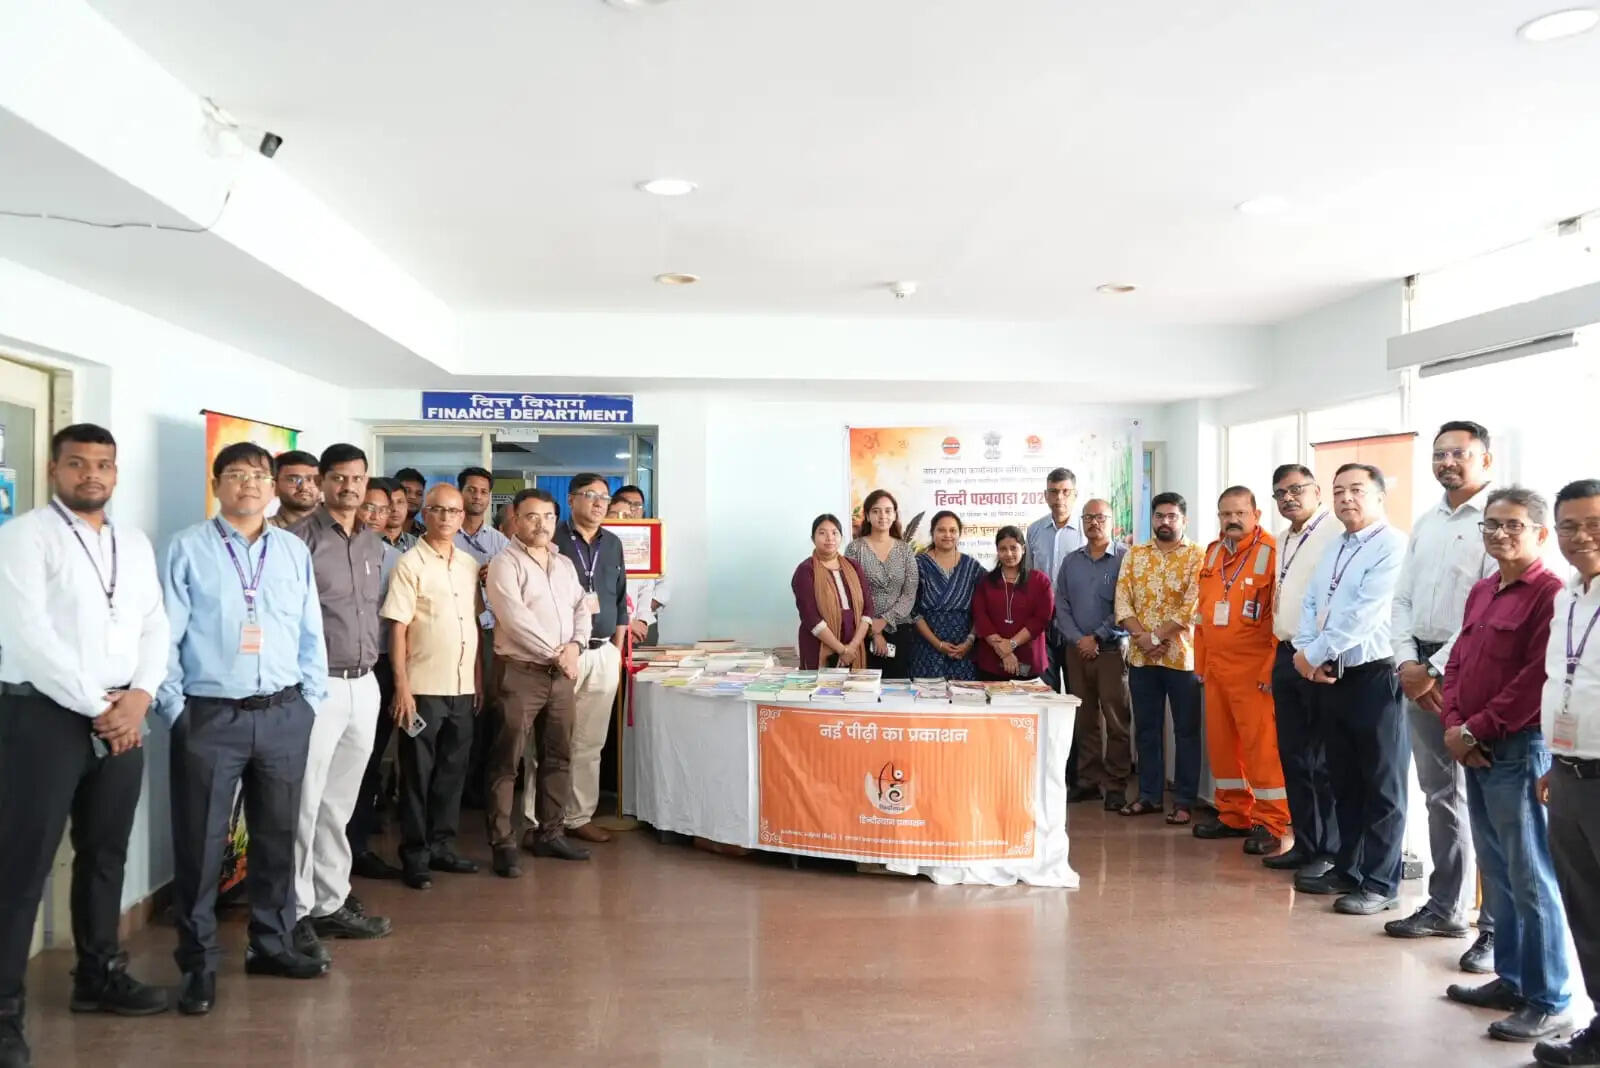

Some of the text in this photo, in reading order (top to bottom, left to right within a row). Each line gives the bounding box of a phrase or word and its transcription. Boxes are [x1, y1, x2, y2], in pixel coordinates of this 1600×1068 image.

[470, 394, 586, 409] वित्त विभाग
[427, 407, 628, 422] FINANCE DEPARTMENT
[935, 489, 967, 507] हिन्दी
[1021, 492, 1047, 505] 202
[818, 720, 968, 744] नई पीढ़ी का प्रकाशन
